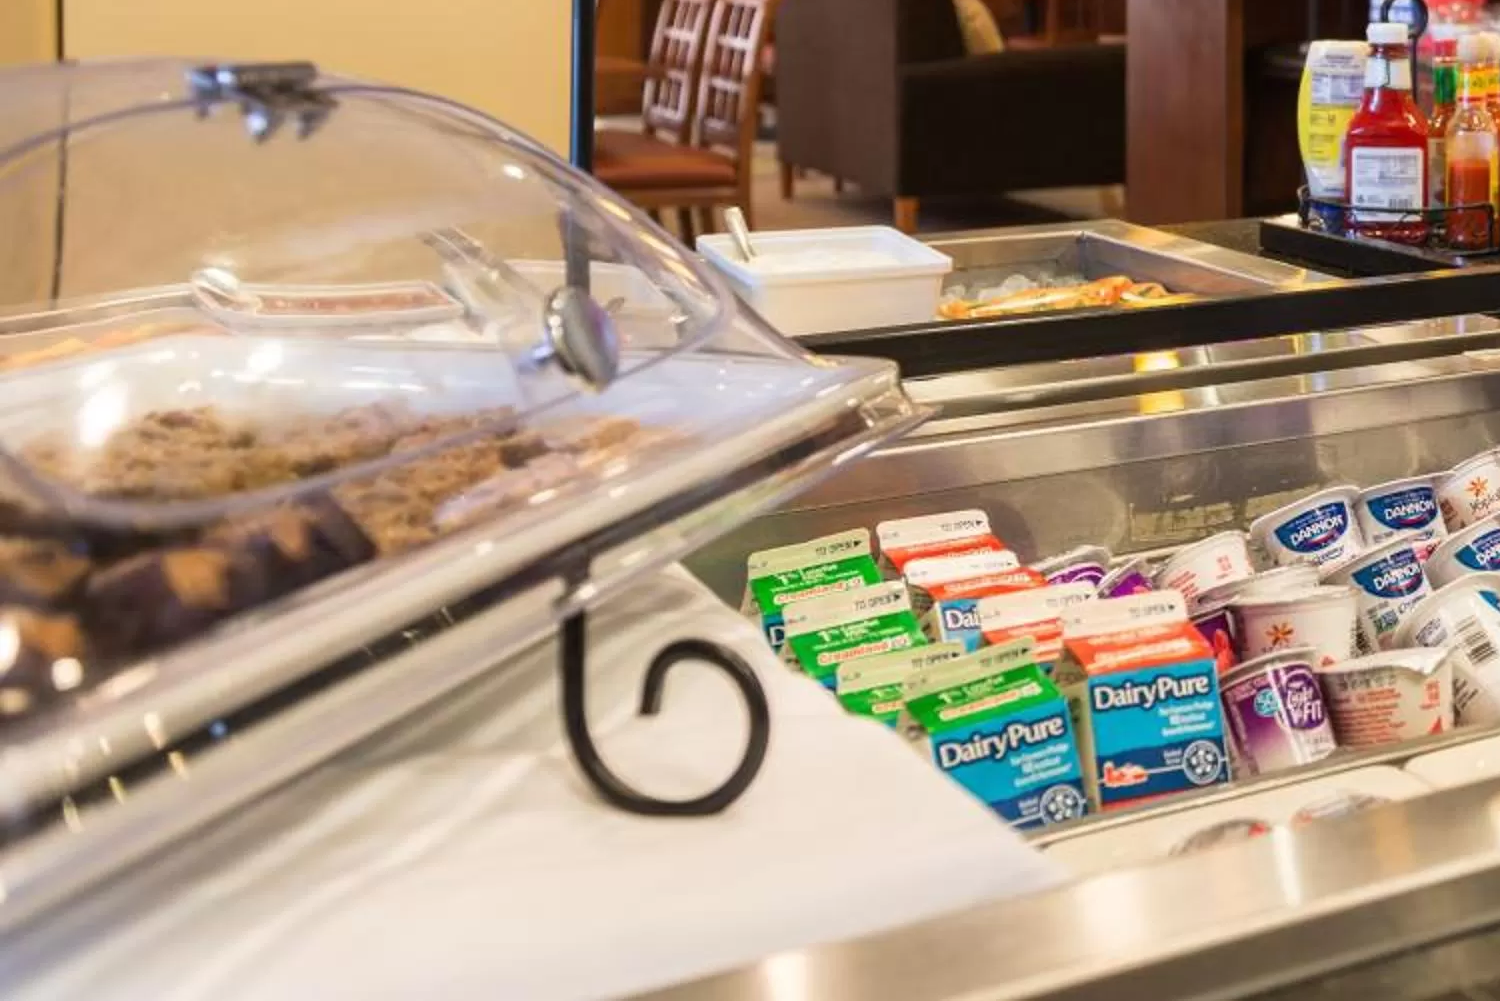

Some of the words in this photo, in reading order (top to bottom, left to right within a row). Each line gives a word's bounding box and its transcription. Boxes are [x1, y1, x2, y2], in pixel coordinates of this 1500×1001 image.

[1384, 499, 1435, 520] DANNON
[1290, 514, 1344, 546] DANNON
[1093, 675, 1210, 709] DairyPure
[939, 716, 1065, 768] DairyPure
